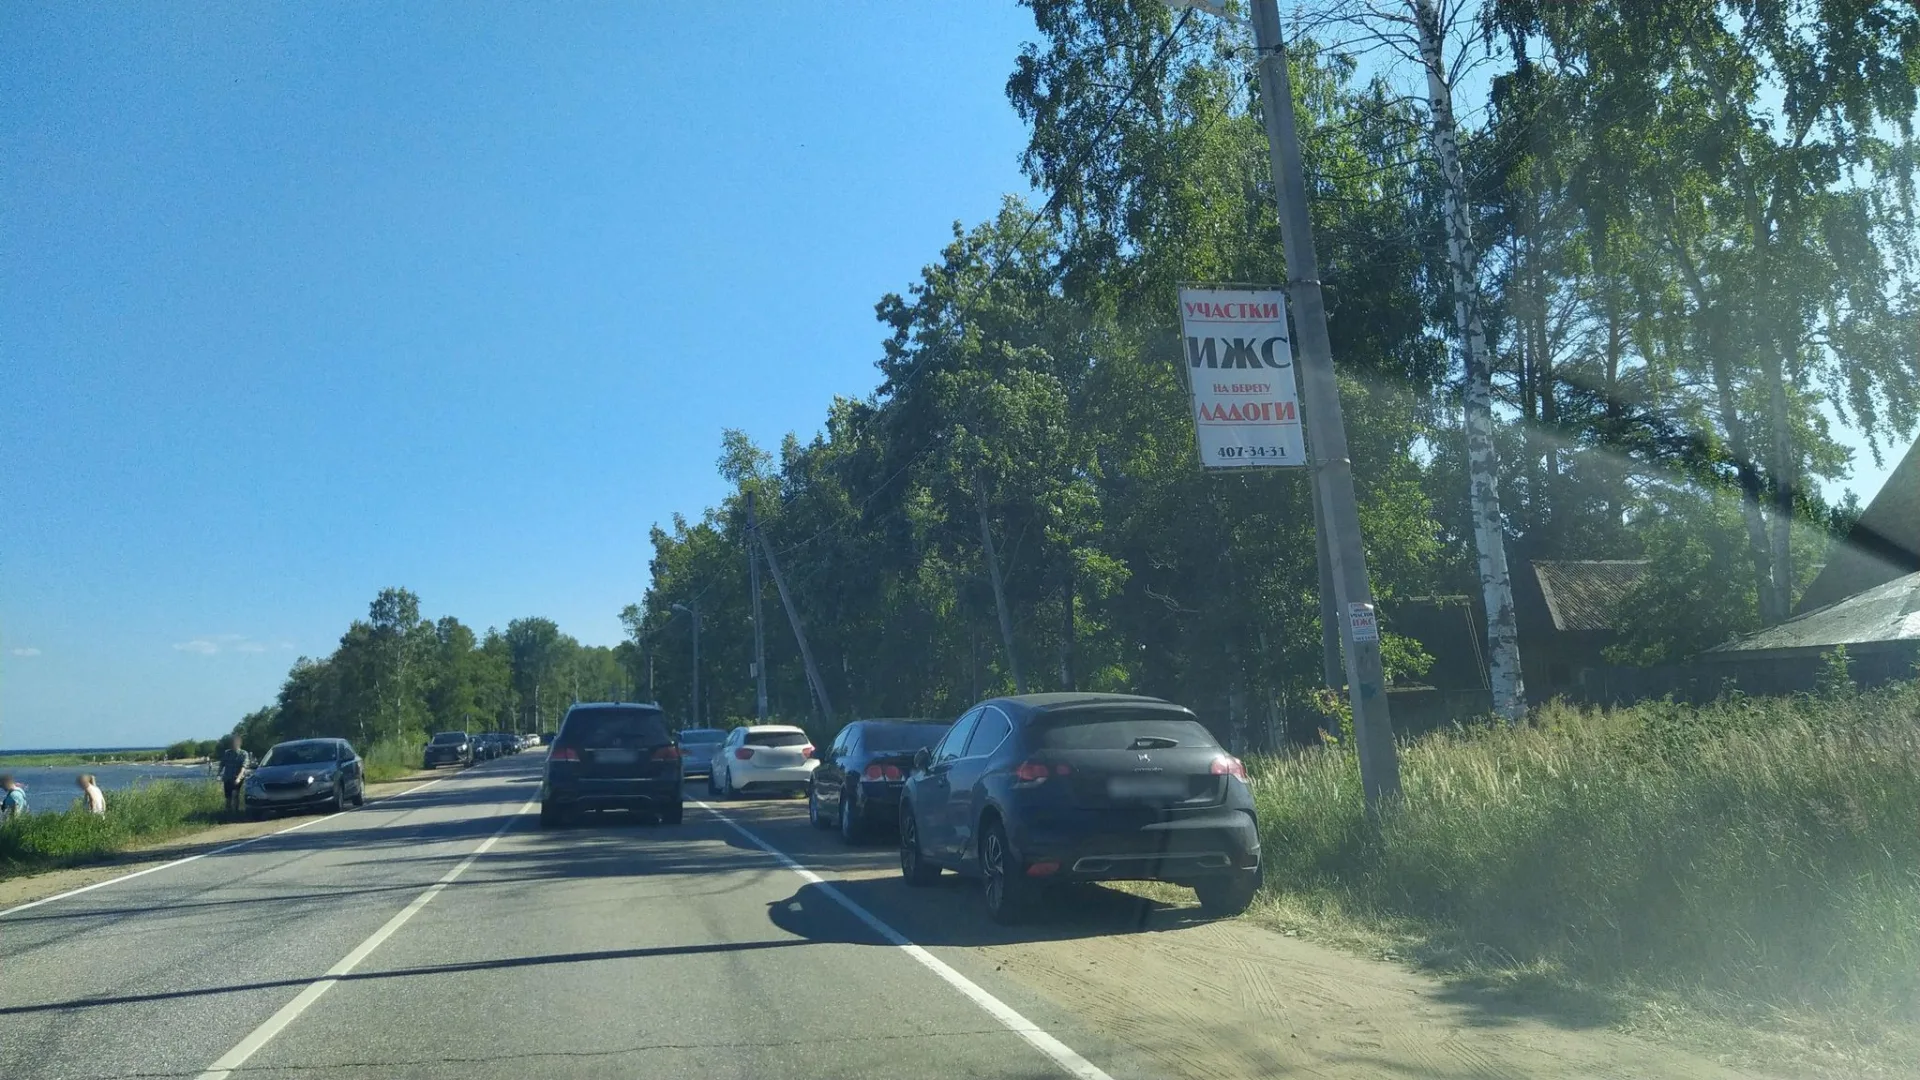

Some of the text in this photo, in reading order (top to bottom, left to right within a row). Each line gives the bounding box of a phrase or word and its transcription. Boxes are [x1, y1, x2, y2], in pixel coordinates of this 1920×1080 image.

[1185, 303, 1279, 319] УЧАСТКИ
[1188, 336, 1291, 369] ИЖС
[1213, 383, 1271, 393] НА БЕРЕГУ
[1198, 401, 1295, 421] ЛАДОГИ
[1218, 446, 1286, 458] 407-34-31
